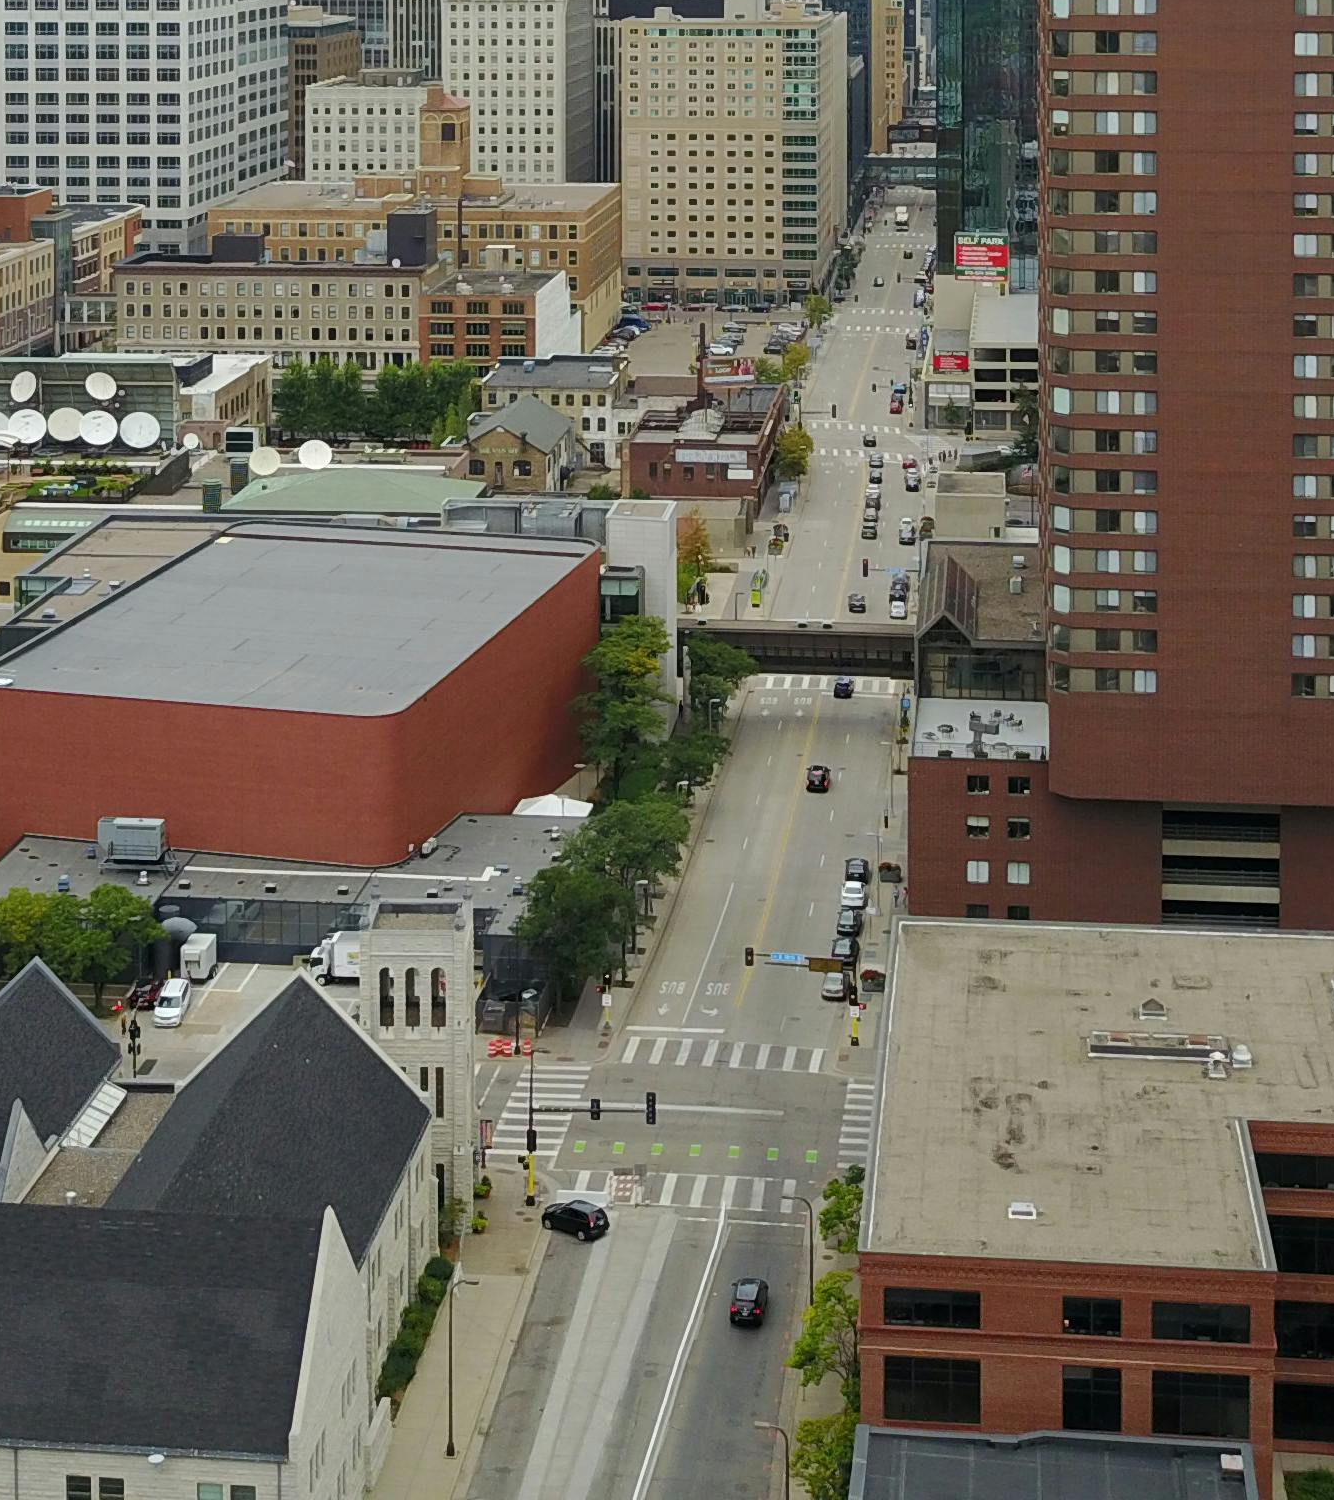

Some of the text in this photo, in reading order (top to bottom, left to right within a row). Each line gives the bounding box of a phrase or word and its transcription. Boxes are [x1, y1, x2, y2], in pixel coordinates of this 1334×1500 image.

[957, 236, 1004, 245] SELF PARK
[659, 981, 685, 995] BUS
[705, 982, 731, 996] BUS
